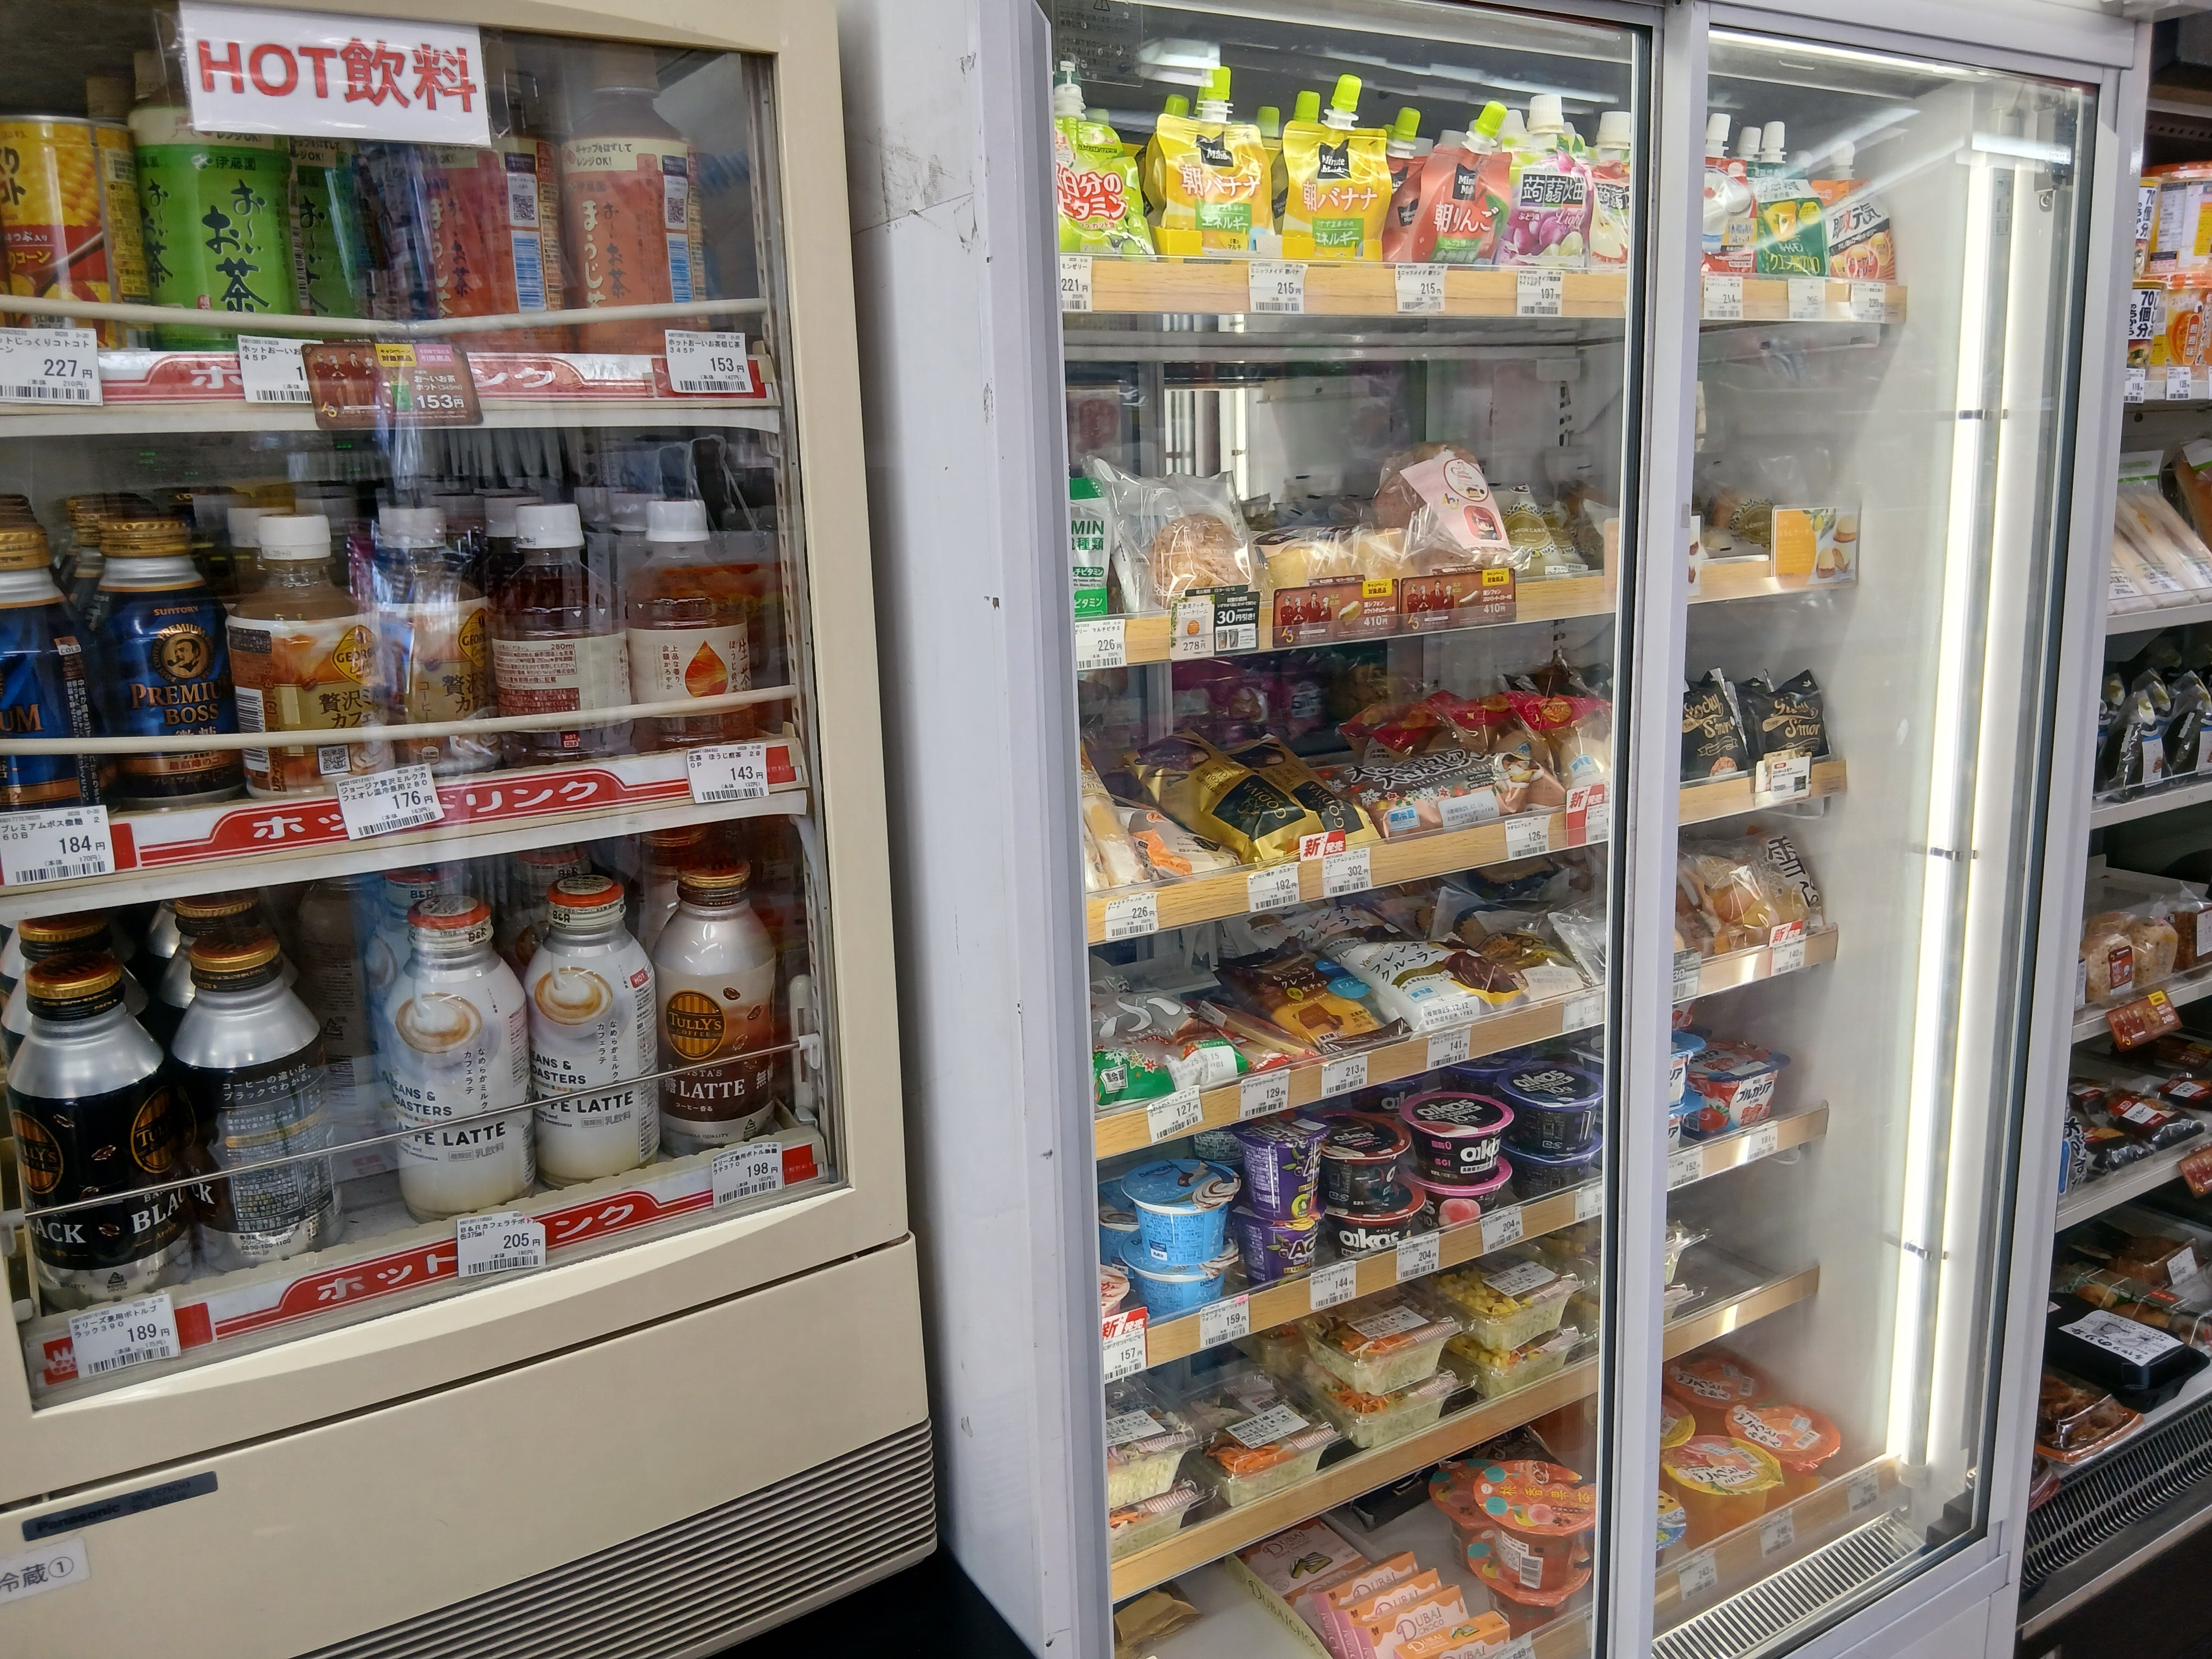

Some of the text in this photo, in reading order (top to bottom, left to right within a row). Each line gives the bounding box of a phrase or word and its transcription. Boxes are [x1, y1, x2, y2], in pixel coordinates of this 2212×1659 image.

[197, 38, 478, 112] HOT飲料
[576, 143, 632, 153] キャップをはずして
[576, 157, 612, 166] レンジOK!
[1322, 154, 1346, 166] Minute
[1181, 164, 1262, 197] 朝バナナ
[1302, 179, 1378, 213] 朝バナナ
[1521, 174, 1586, 205] 蒟蒻畑
[1201, 215, 1249, 231] エネルギー
[1433, 202, 1499, 233] 朝りんご
[1554, 209, 1584, 232] Light
[1315, 230, 1360, 246] エネルギー
[1061, 278, 1088, 292] 221円
[1277, 282, 1301, 295] 215円
[1420, 282, 1442, 295] 215円
[2137, 290, 2156, 339] 70個分
[44, 358, 93, 379] 227円
[710, 357, 745, 373] 153円
[416, 394, 465, 409] 153円
[1074, 597, 1103, 608] ビタミン
[1483, 602, 1506, 614] 410円
[153, 606, 199, 616] SUNTORY
[1217, 610, 1256, 625] 30円引き!
[1363, 616, 1388, 627] 410円
[1097, 639, 1122, 652] 226円
[1183, 640, 1206, 651] 278円
[164, 704, 219, 725] BOSS
[730, 766, 764, 781] 143円
[341, 772, 427, 794] ジョージア贅沢ミルクカ
[392, 790, 434, 809] 176円
[1243, 782, 1287, 819] GODIVA
[1309, 783, 1345, 828] GODIVA
[59, 835, 106, 854] 184円
[1303, 837, 1345, 858] 新発売
[1348, 865, 1369, 877] 302円
[1276, 878, 1297, 891] 192円
[552, 910, 571, 923] B&R
[1131, 906, 1155, 919] 226円
[1369, 942, 1423, 974] フレンチ
[1381, 950, 1440, 982] クルーラー
[634, 973, 646, 984] HOT
[1281, 971, 1315, 989] クレープ
[1301, 979, 1328, 993] 生チョコ
[668, 1012, 723, 1033] TULLY'S
[676, 1028, 712, 1037] COFFEE
[597, 1023, 607, 1065] カフェラテ
[1450, 1040, 1468, 1051] 141円
[464, 1051, 474, 1095] カフェラテ
[563, 1060, 571, 1070] &
[1345, 1064, 1365, 1077] 213円
[222, 1063, 310, 1090] コーヒーの違いは、
[1512, 1069, 1567, 1088] oikos
[223, 1074, 311, 1101] ブラックでわかる。
[679, 1077, 745, 1099] LATTE
[1266, 1088, 1286, 1099] 129円
[1736, 1081, 1773, 1103] ブルガリア
[427, 1091, 436, 1101] &
[577, 1090, 634, 1114] LATTE
[675, 1102, 713, 1113] コーヒー香る
[1176, 1102, 1198, 1117] 127円
[1417, 1098, 1475, 1116] oikos
[605, 1110, 631, 1126] 乳飲料
[442, 1121, 506, 1147] LATTE
[474, 1142, 505, 1159] 乳飲料
[747, 1162, 778, 1178] 198円
[1502, 1219, 1521, 1232] 204円
[503, 1233, 541, 1250] 205円
[1339, 1228, 1400, 1248] oikos
[1418, 1250, 1437, 1261] 204円
[1335, 1277, 1354, 1290] 144円
[1226, 1313, 1246, 1326] 159円
[127, 1323, 170, 1342] 189円
[1121, 1347, 1142, 1362] 157円
[36, 1502, 121, 1533] Panasonic
[1396, 1607, 1442, 1643] DUBAI
[1418, 1618, 1444, 1636] CHOCO
[1406, 1634, 1444, 1652] DUBAI
